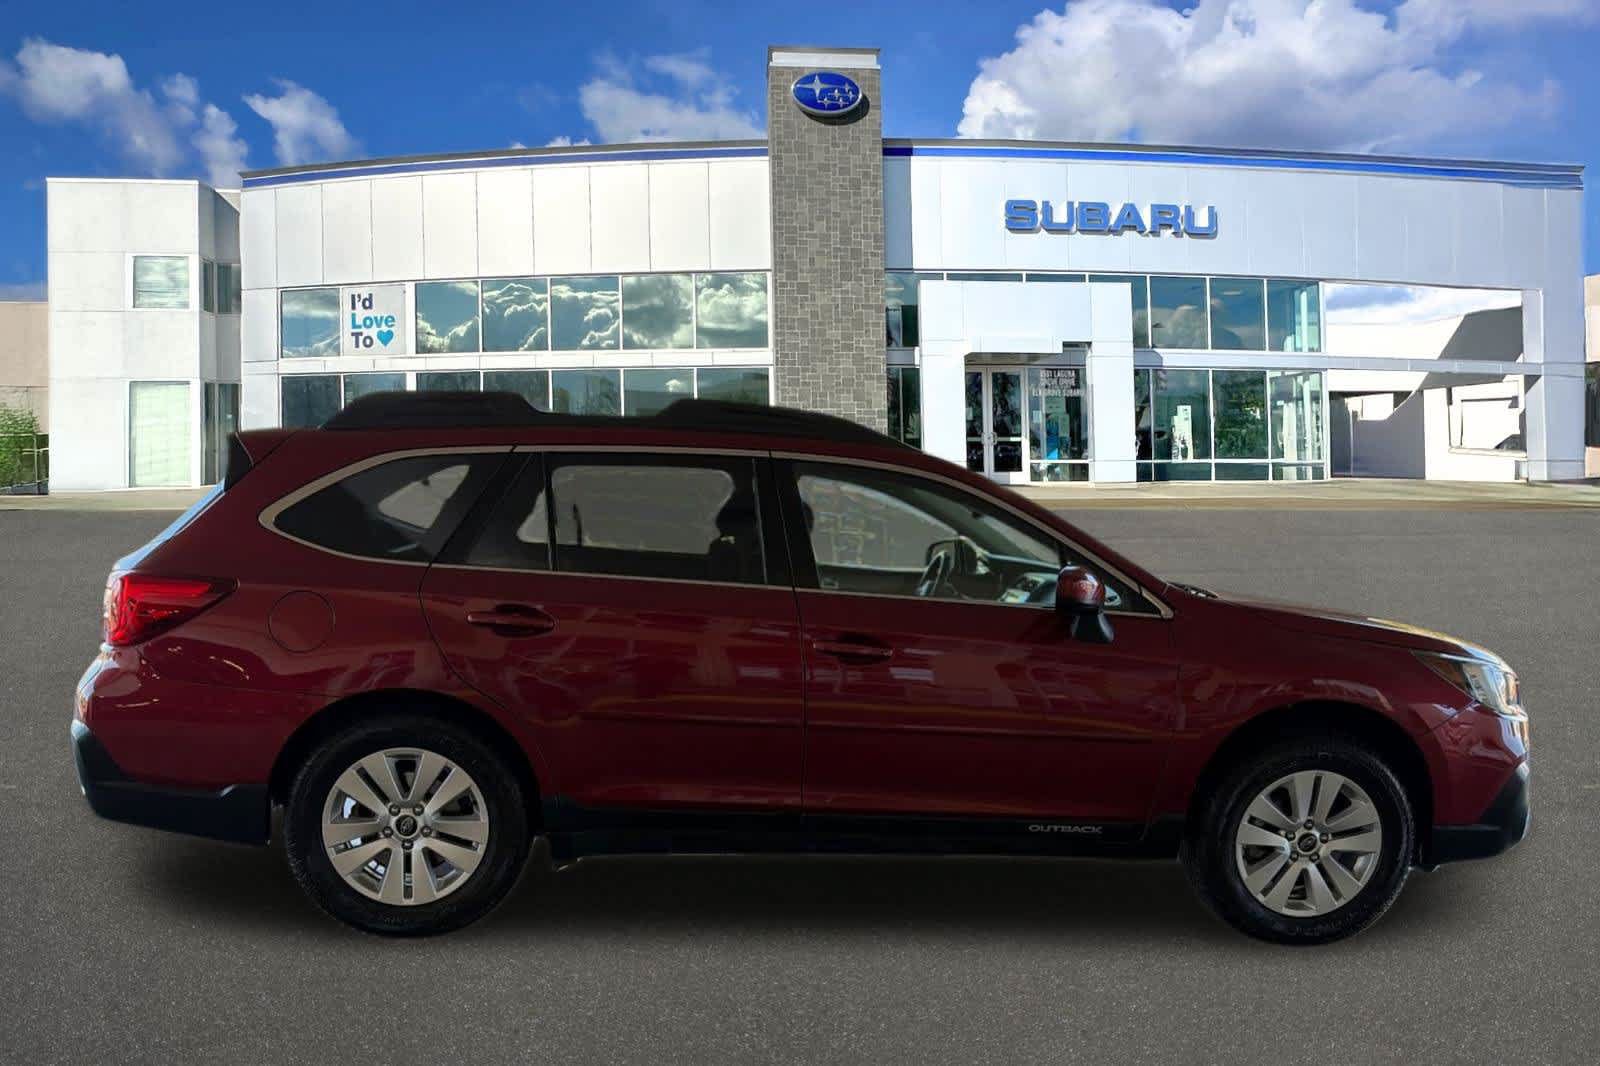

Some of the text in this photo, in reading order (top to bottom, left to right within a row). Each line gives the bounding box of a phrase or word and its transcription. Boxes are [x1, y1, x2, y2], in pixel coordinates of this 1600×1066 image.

[1005, 199, 1217, 238] SUBARU
[351, 293, 374, 311] I'd
[351, 312, 396, 330] Love
[351, 331, 374, 349] To
[1028, 824, 1103, 834] OUTBACK
